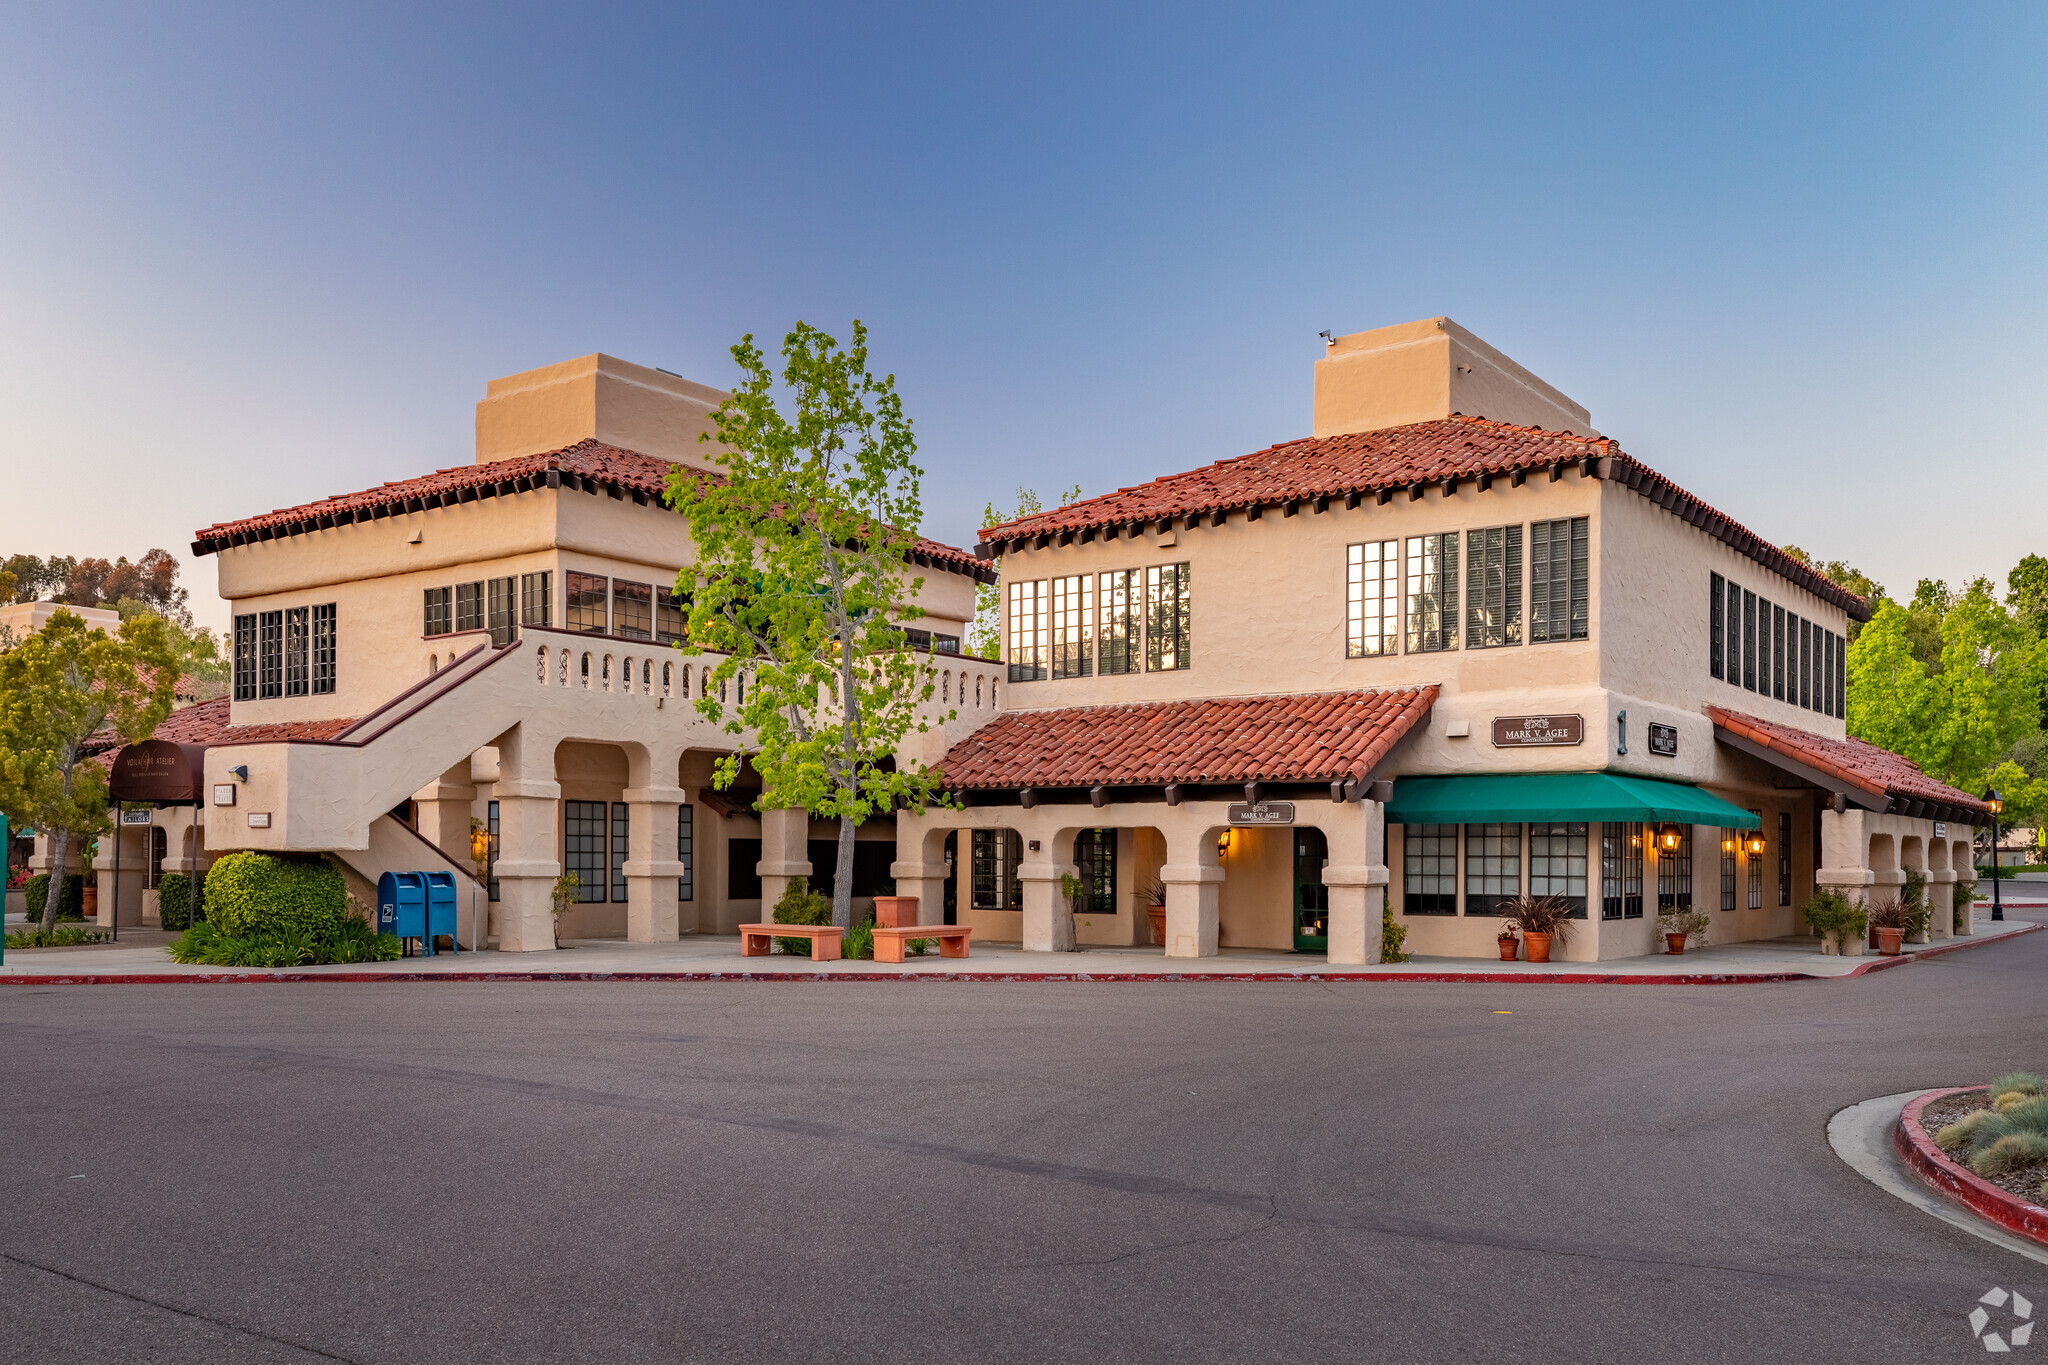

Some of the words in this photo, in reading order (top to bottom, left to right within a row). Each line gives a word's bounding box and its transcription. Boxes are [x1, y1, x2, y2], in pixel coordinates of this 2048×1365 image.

[1505, 730, 1531, 738] MARK
[1534, 730, 1541, 738] V.
[1545, 728, 1568, 738] AGEE
[155, 757, 175, 766] ATELIER
